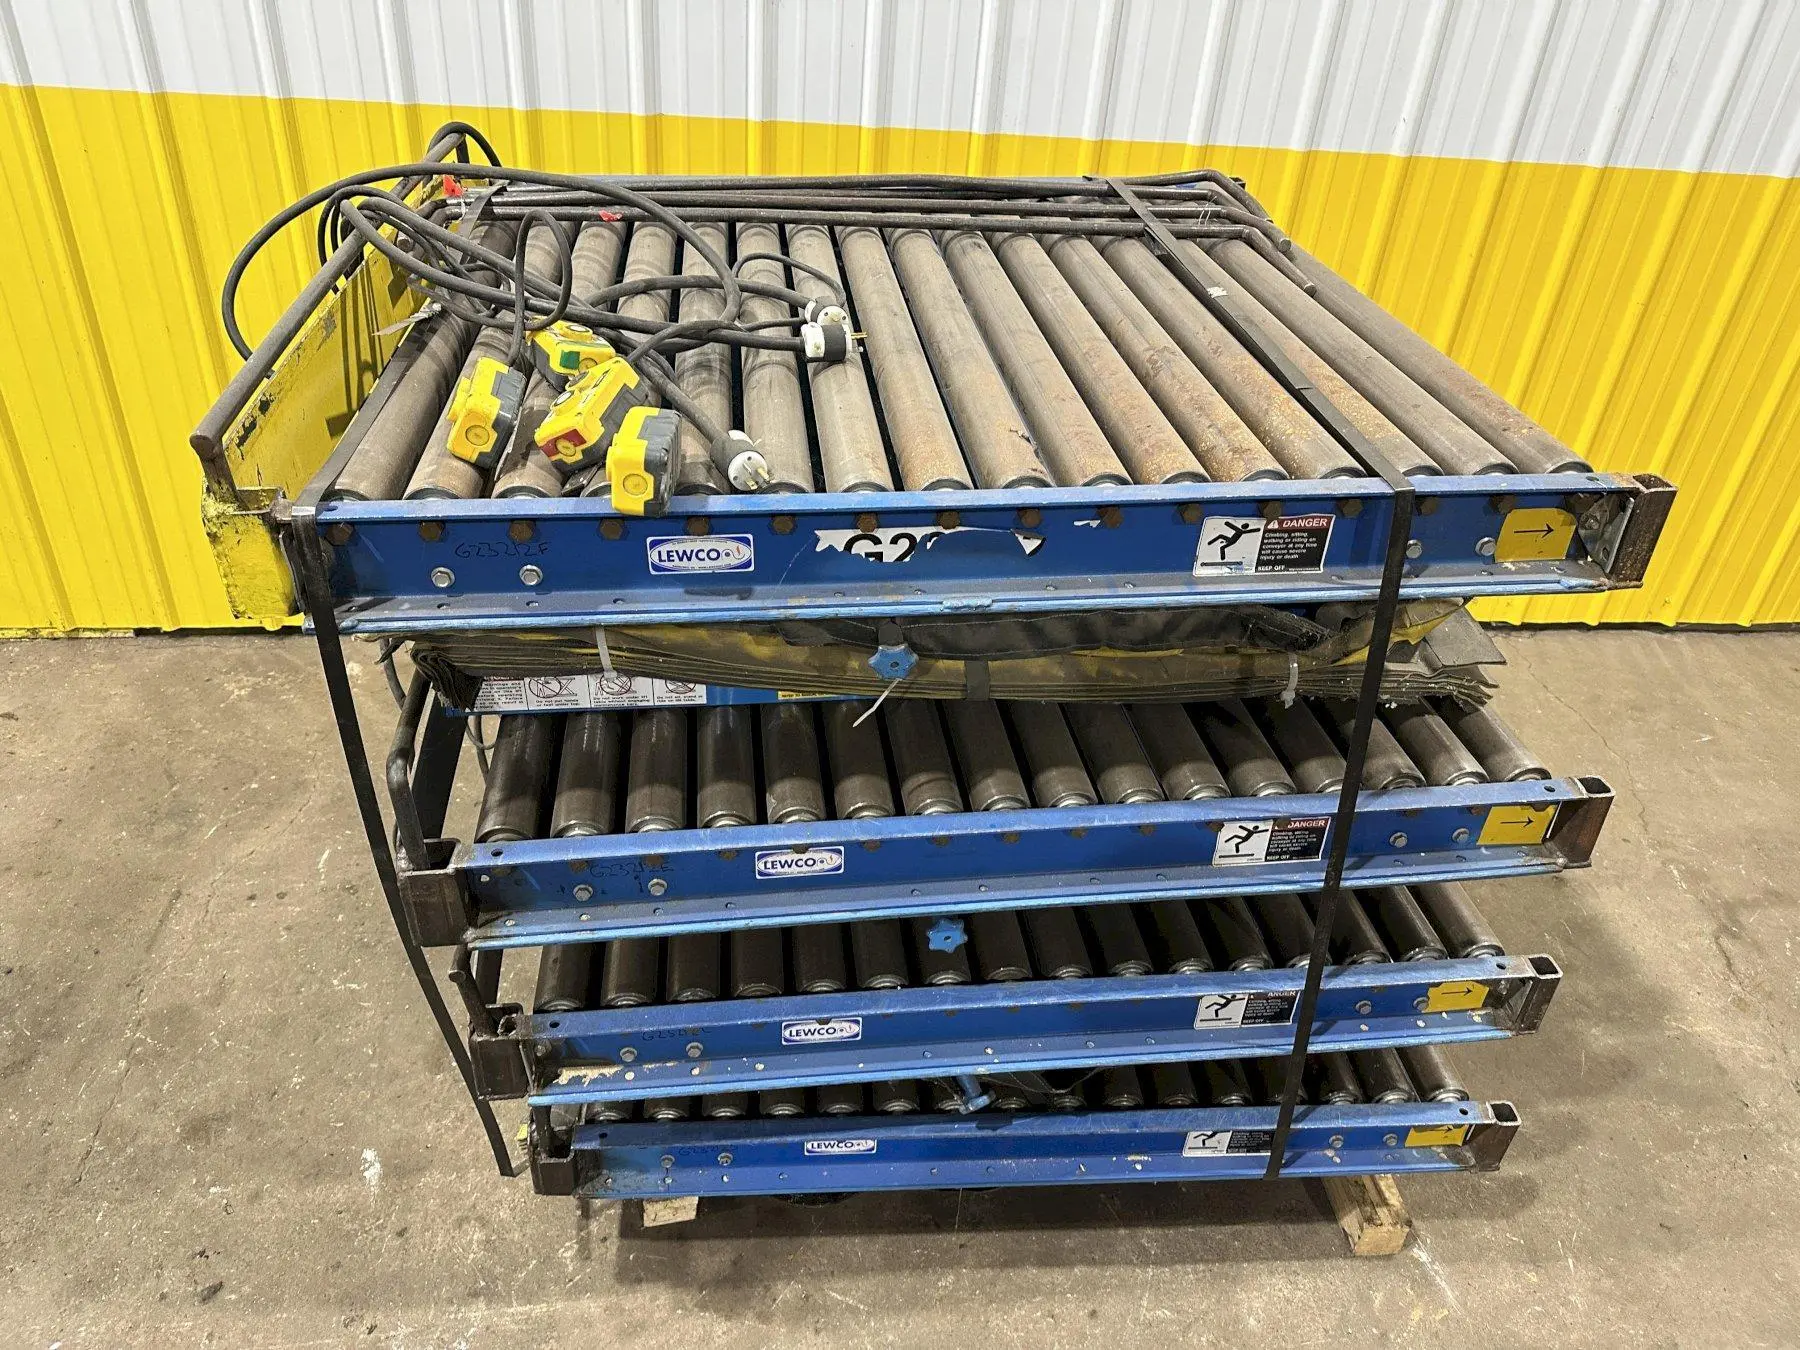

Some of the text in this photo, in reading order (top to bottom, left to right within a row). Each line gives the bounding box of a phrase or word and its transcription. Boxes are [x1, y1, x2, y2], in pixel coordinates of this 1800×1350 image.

[1282, 518, 1328, 528] DANGER
[658, 548, 720, 562] LEWCO
[764, 858, 816, 870] LEWCO
[789, 1027, 836, 1037] LEWCO
